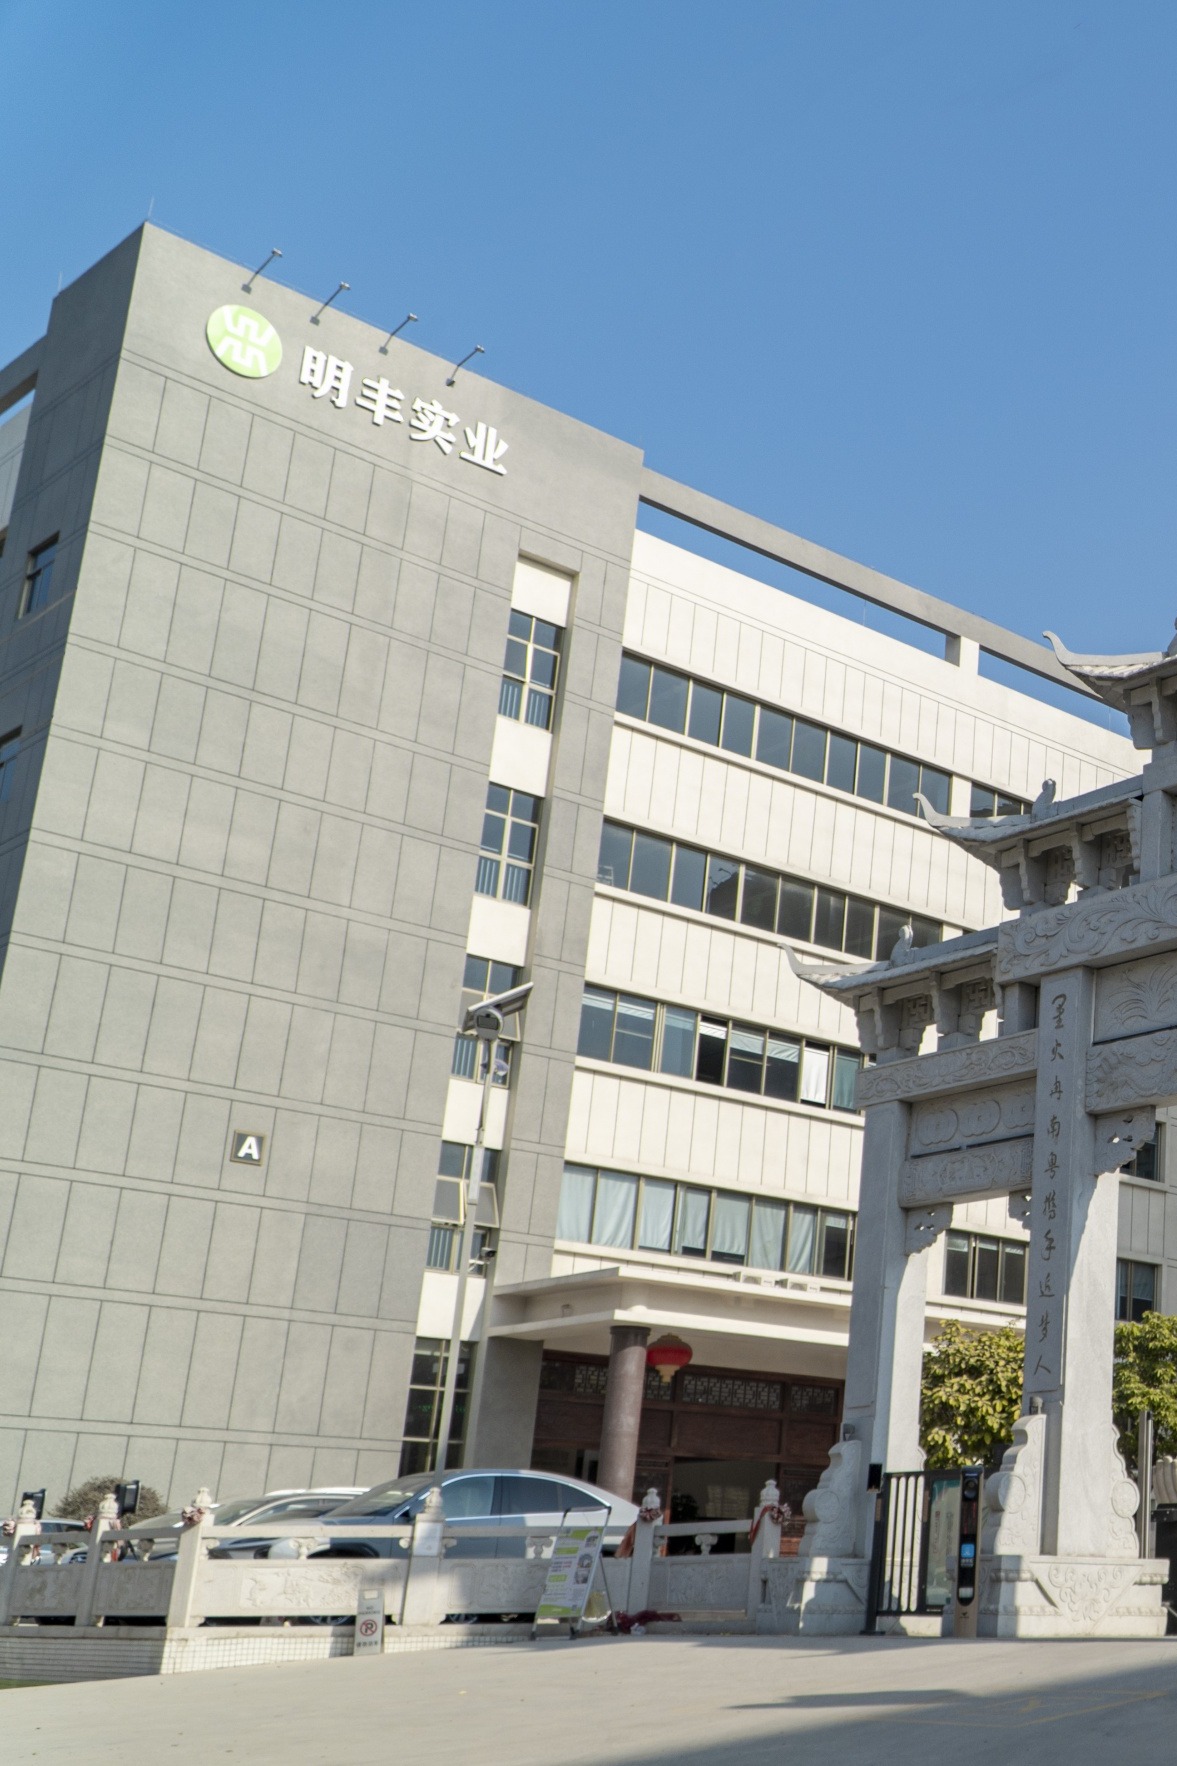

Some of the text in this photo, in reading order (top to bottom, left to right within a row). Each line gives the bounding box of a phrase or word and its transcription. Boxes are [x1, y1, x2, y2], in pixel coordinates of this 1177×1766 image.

[300, 346, 509, 475] 明丰实业
[237, 1136, 260, 1160] A
